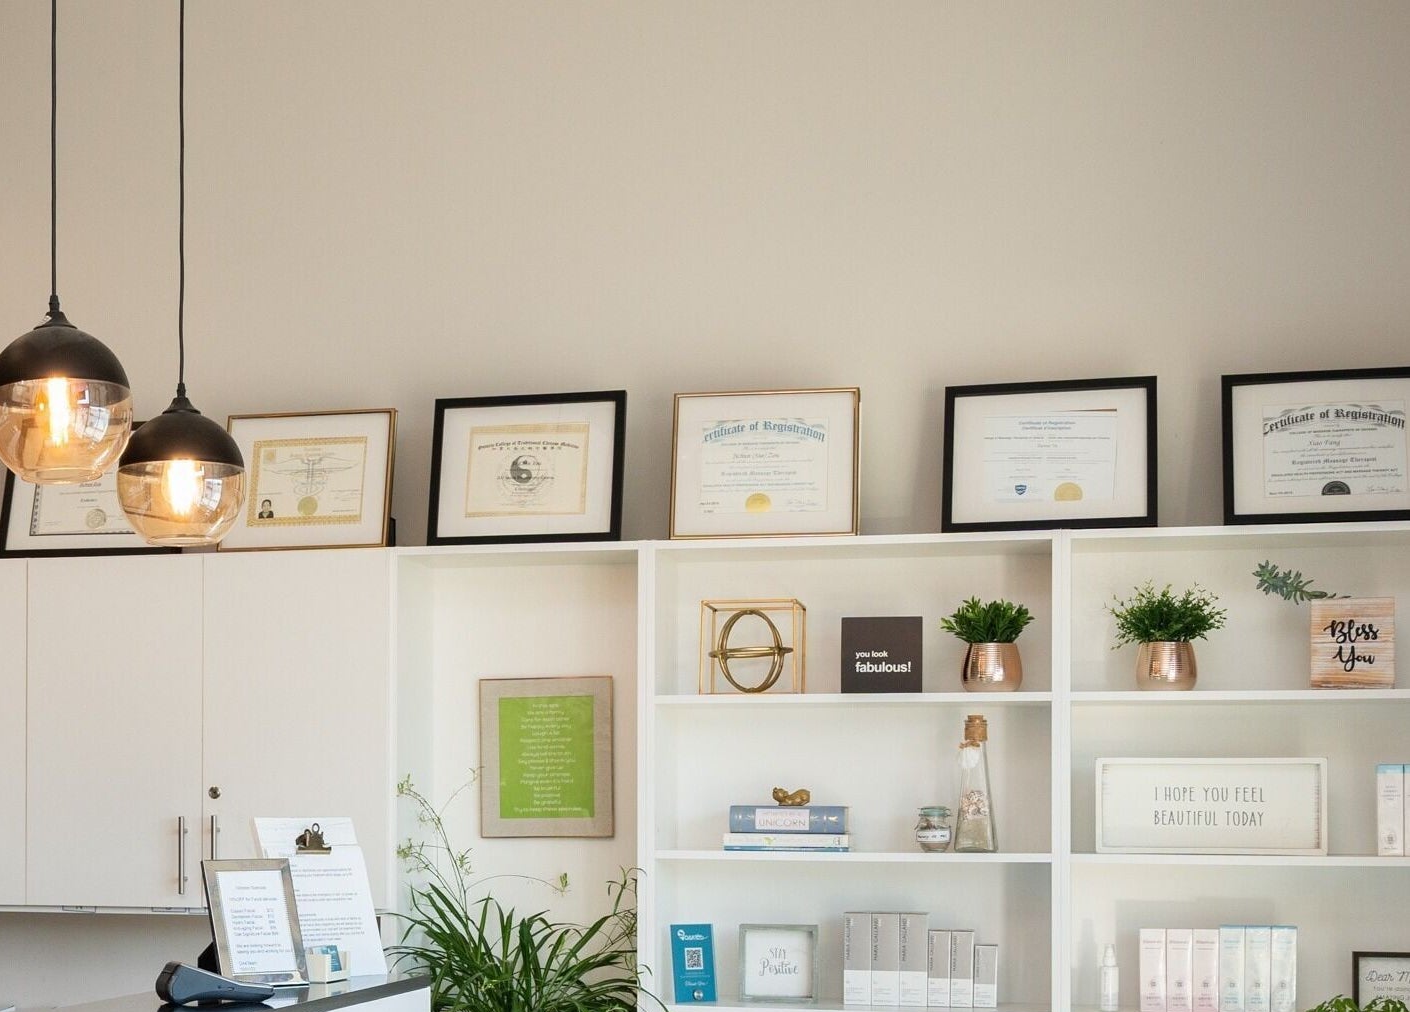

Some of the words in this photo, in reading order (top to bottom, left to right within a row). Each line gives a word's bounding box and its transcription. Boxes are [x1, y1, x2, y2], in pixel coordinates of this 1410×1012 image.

[1319, 409, 1330, 419] of
[1333, 408, 1406, 430] Registration
[702, 423, 747, 442] ertificate
[749, 421, 759, 431] of
[762, 420, 826, 442] Registration
[1323, 618, 1379, 644] Bless
[855, 651, 870, 660] you
[871, 649, 889, 659] look
[1332, 645, 1376, 672] You
[854, 661, 913, 673] fabulous!
[1154, 786, 1159, 802] I
[1163, 786, 1196, 802] HOPE
[1202, 786, 1229, 802] YOU
[1235, 786, 1265, 803] FEEL
[758, 819, 806, 828] UNICORN
[1153, 809, 1219, 827] BEAUTIFUL
[1225, 810, 1265, 827] TODAY
[759, 958, 799, 977] Positive
[1365, 969, 1394, 982] Dear
